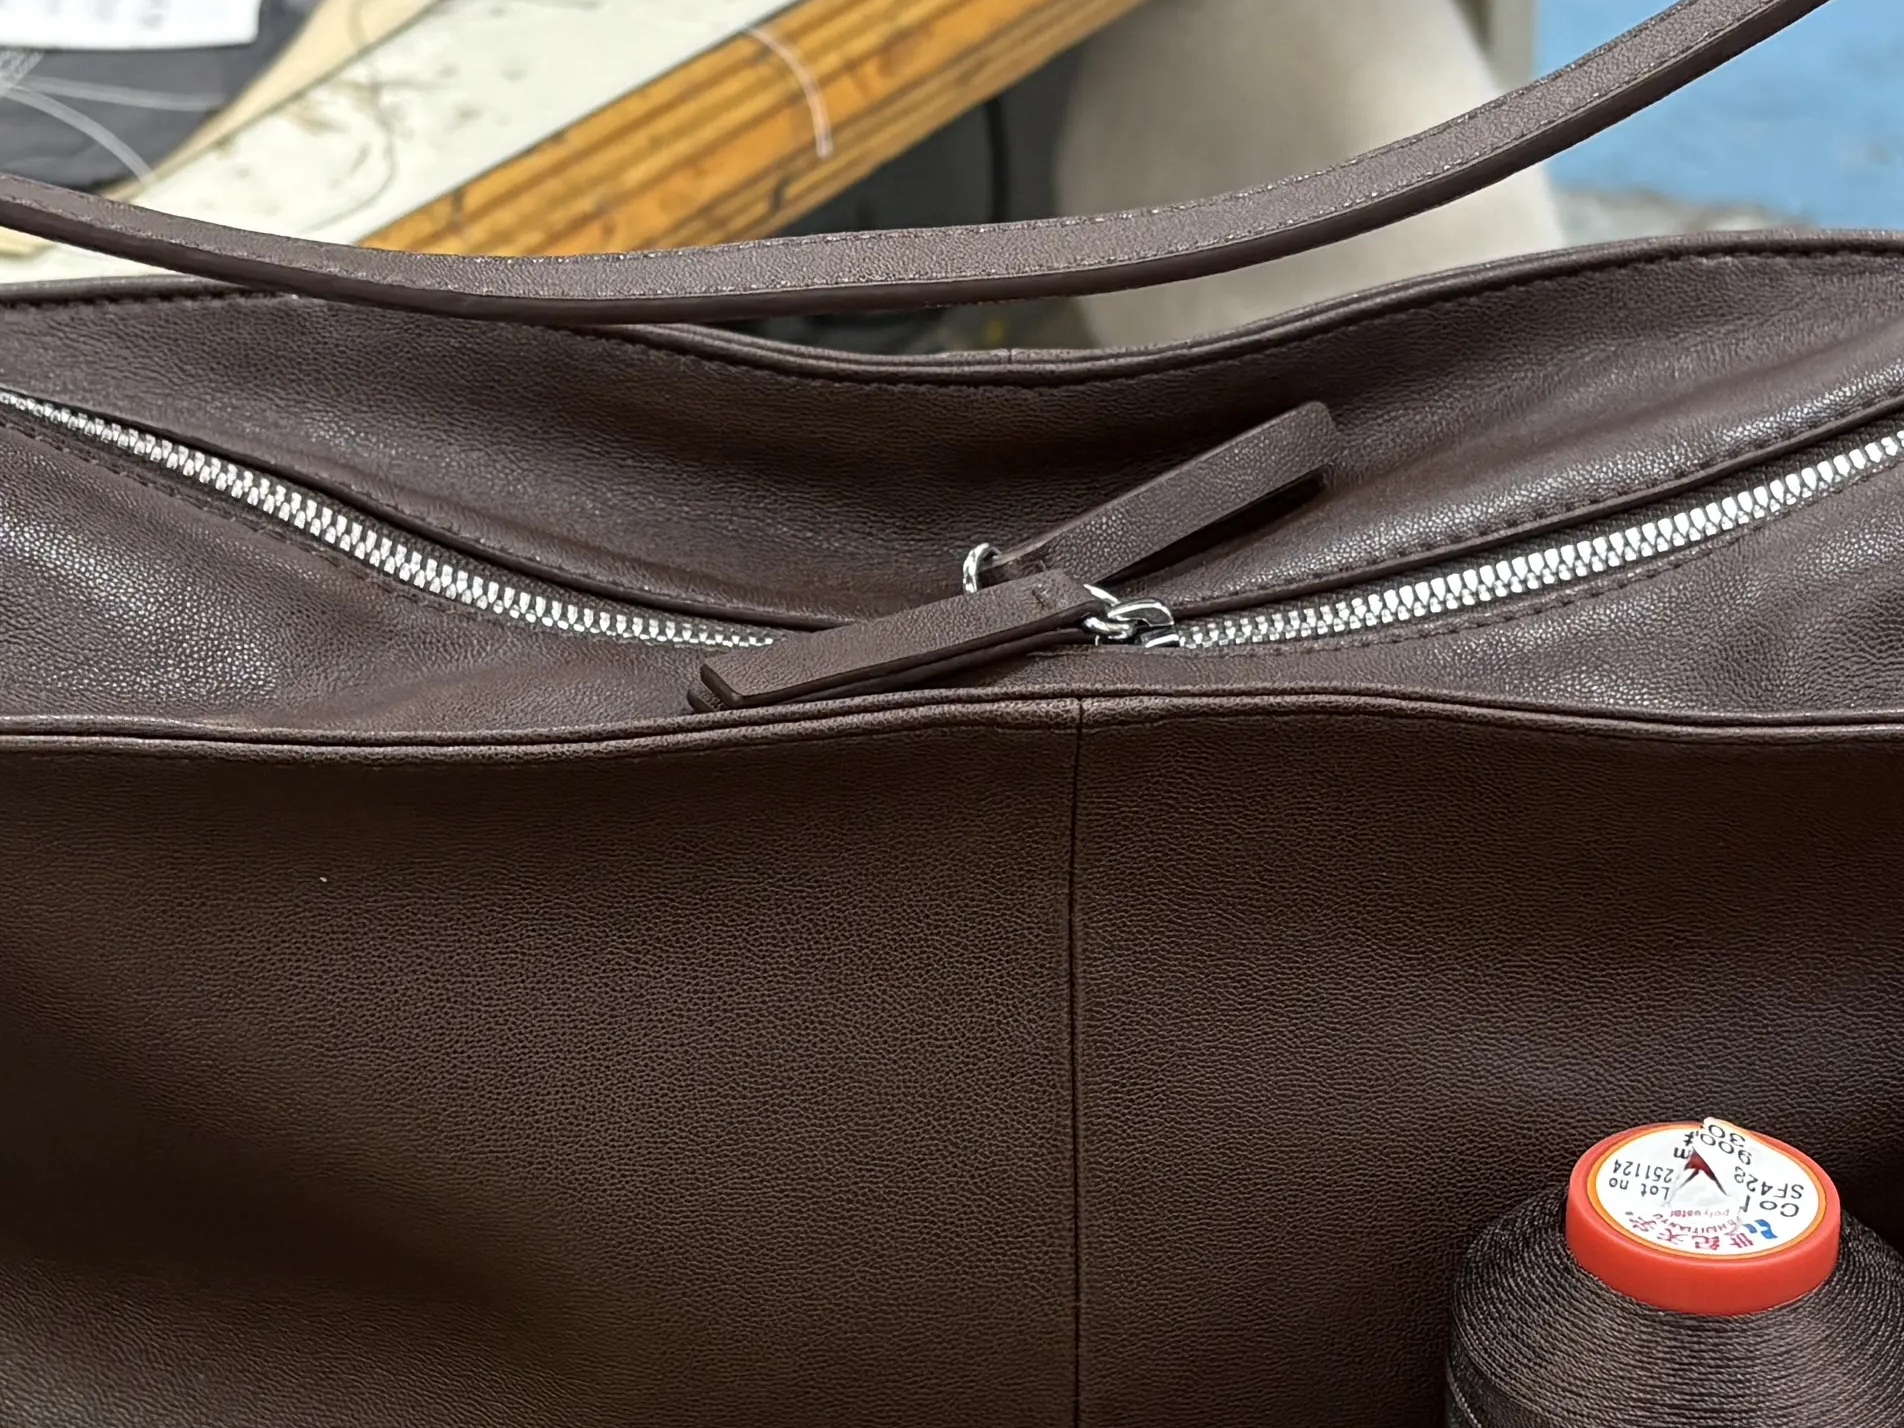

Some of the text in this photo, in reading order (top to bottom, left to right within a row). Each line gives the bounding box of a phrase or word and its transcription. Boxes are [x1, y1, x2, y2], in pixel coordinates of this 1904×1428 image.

[1612, 1158, 1674, 1184] 251124
[1608, 1177, 1670, 1201] Lot no
